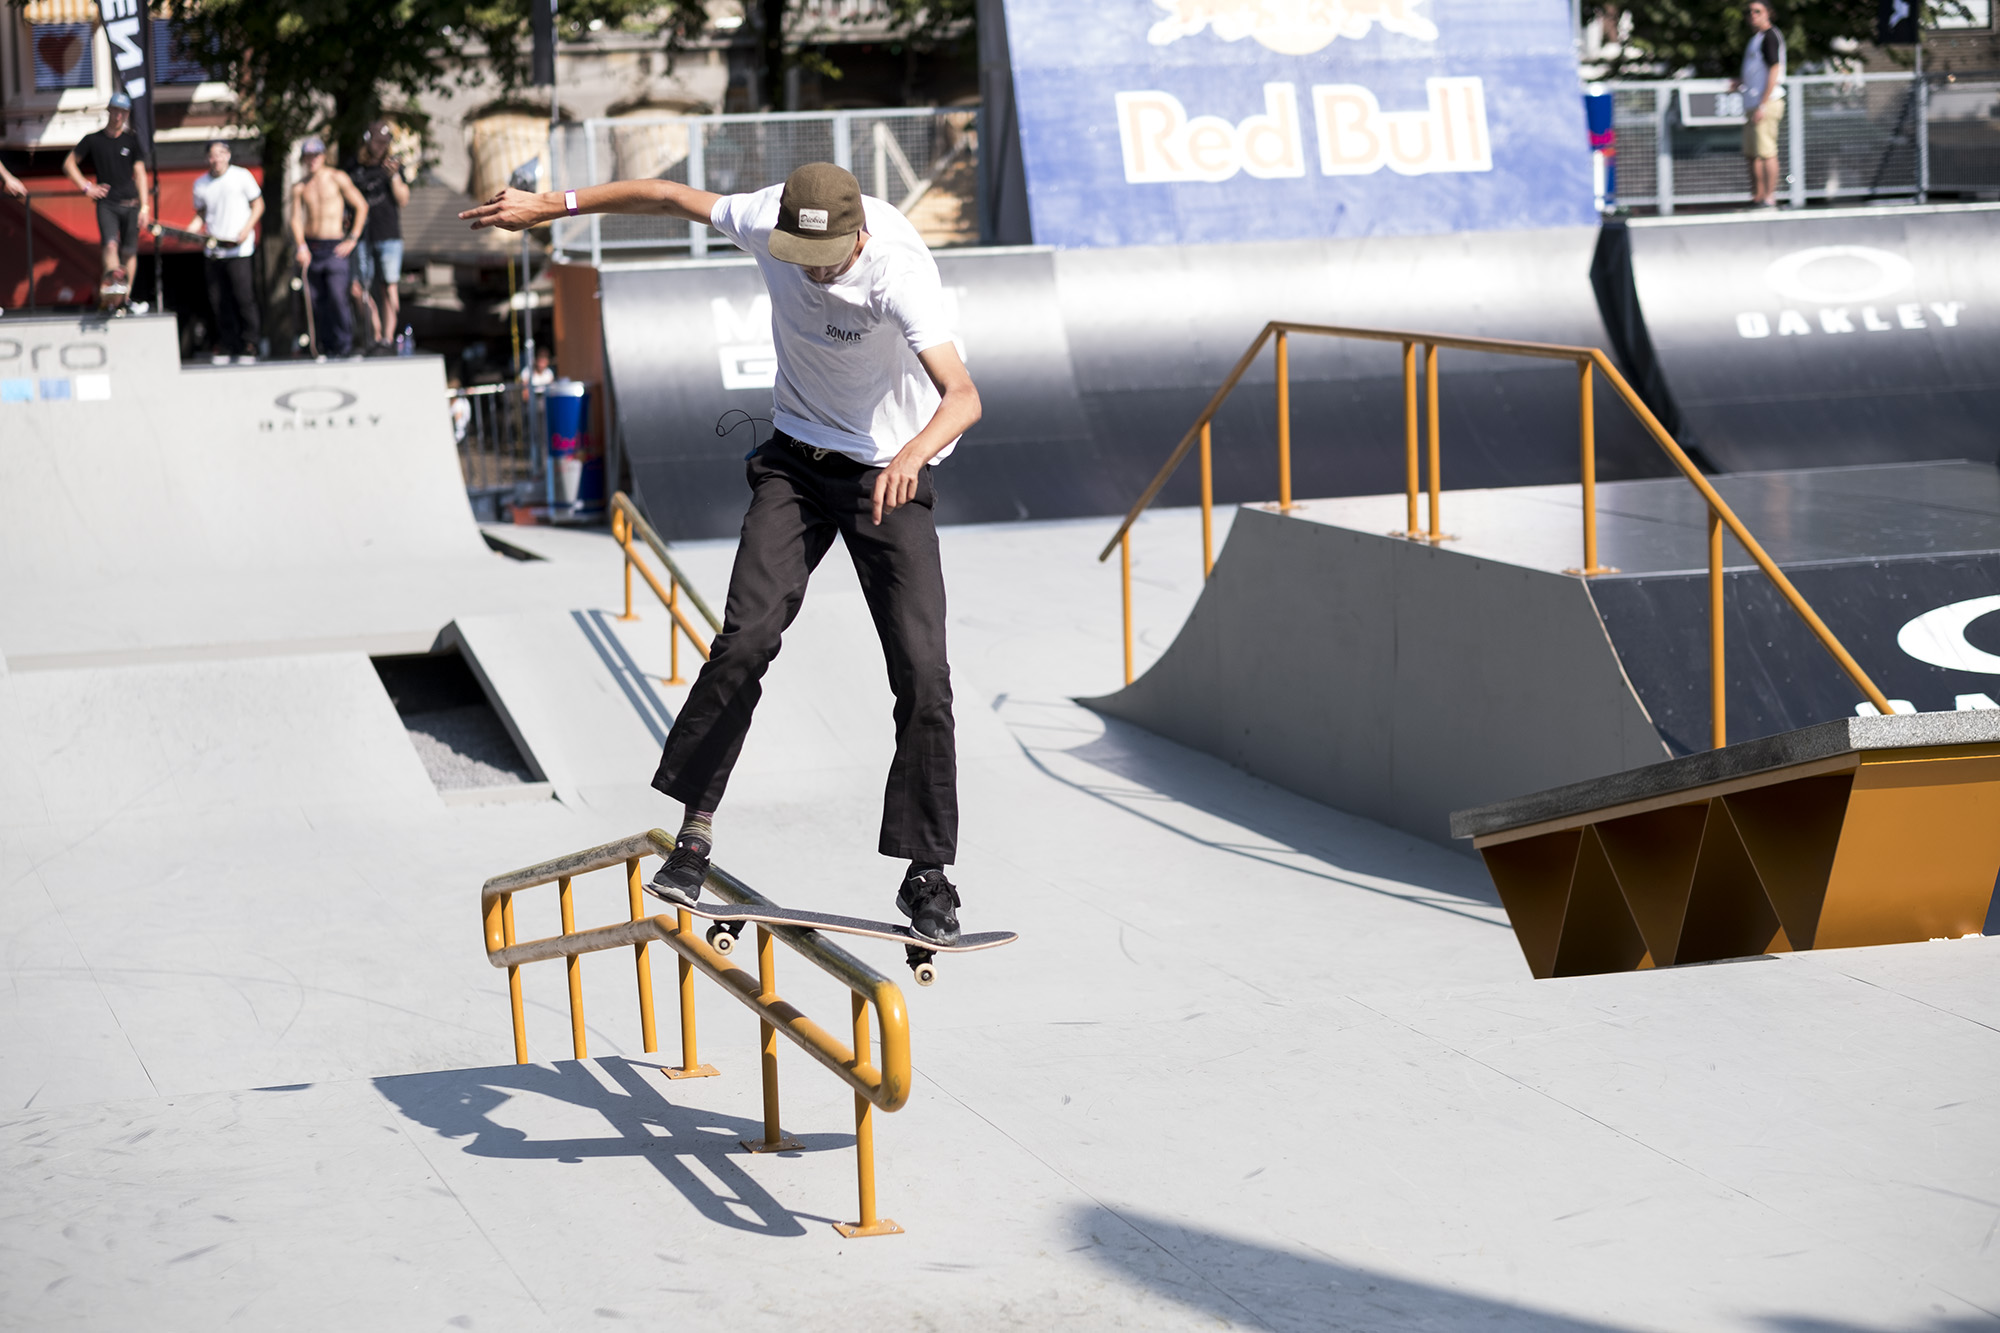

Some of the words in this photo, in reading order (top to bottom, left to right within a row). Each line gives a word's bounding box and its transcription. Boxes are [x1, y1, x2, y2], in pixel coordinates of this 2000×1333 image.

[1115, 82, 1304, 183] Red
[1312, 76, 1493, 176] Bull
[825, 324, 861, 342] SONAR
[1736, 301, 1960, 338] OAKLEY
